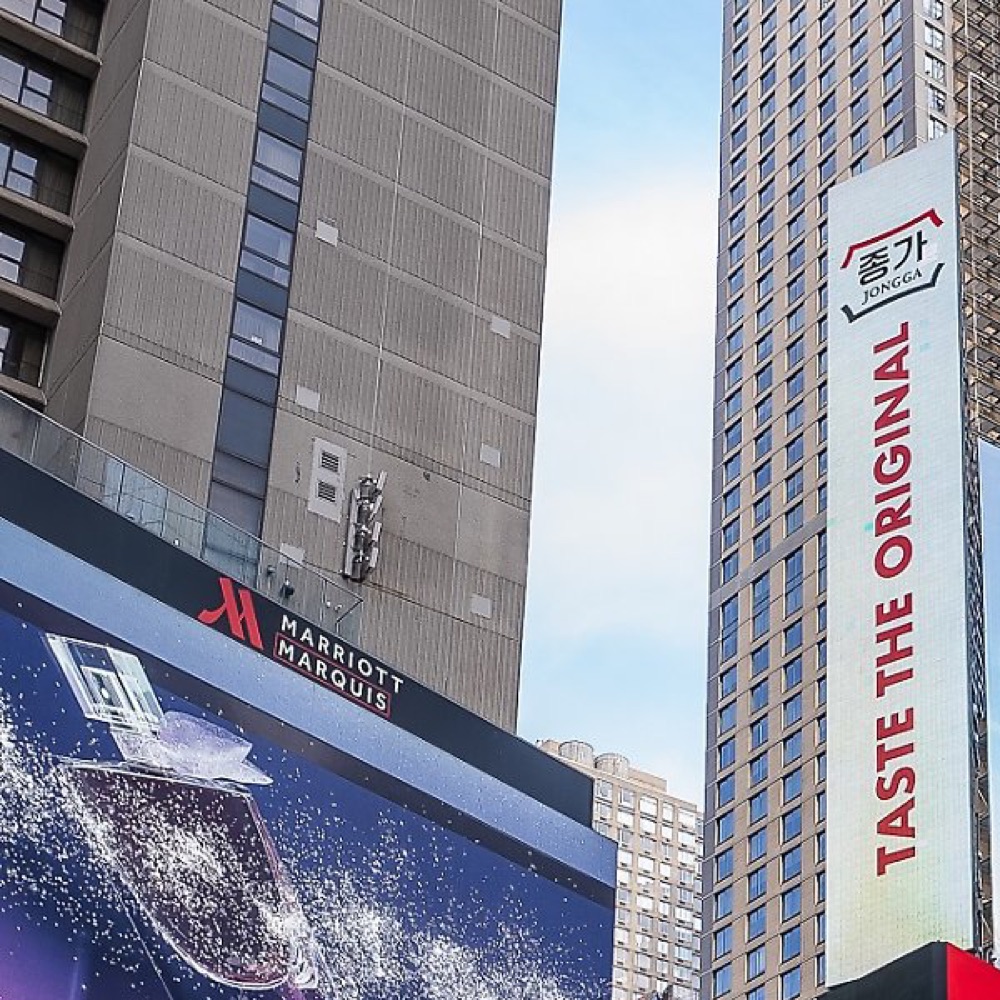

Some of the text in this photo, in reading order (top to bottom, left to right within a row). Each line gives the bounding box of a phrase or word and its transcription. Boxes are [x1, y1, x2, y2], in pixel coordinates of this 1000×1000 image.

[861, 269, 923, 305] JONGGA
[872, 321, 917, 876] TASTE THE ORIGINAL
[277, 638, 389, 712] MARQUIS
[281, 614, 404, 695] MARRIOTT
